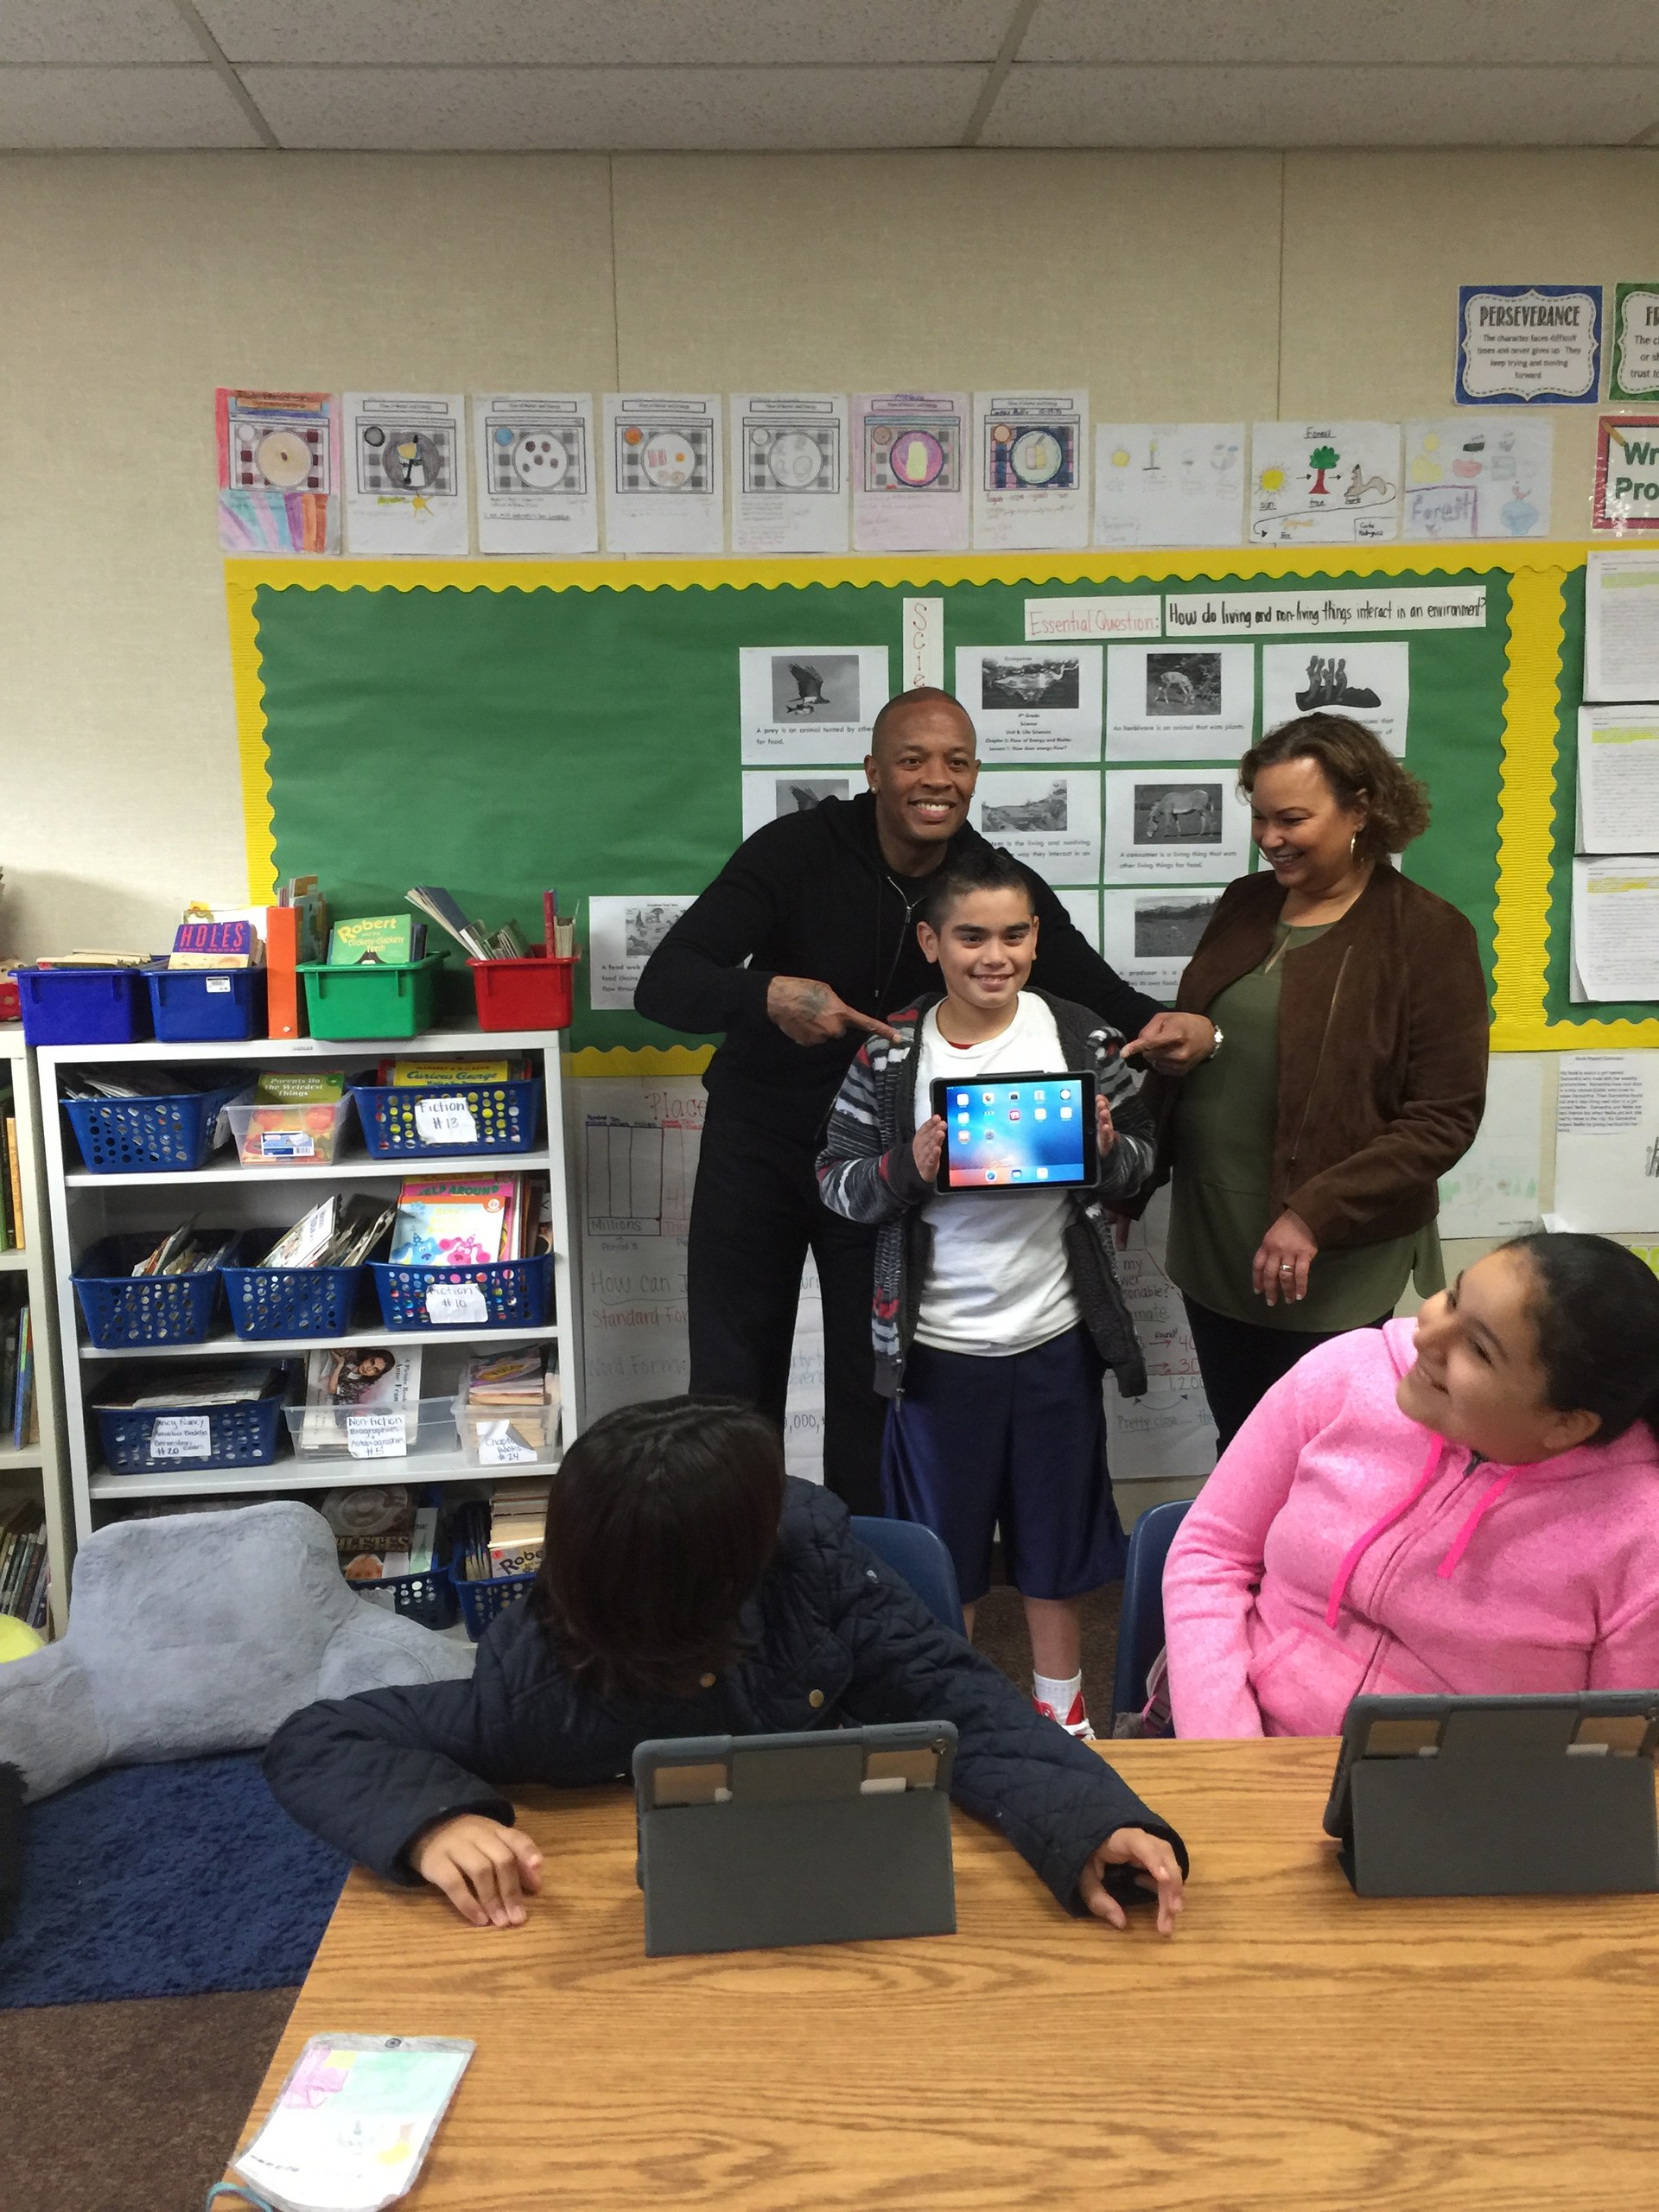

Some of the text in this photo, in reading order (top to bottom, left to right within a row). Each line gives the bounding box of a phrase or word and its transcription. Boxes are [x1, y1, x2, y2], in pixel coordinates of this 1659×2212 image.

[1479, 305, 1580, 327] PERSEVERANCE
[1483, 334, 1577, 342] The character faces difficult
[1634, 334, 1651, 345] The
[1565, 346, 1582, 355] They
[1490, 359, 1506, 367] keep
[1508, 359, 1528, 368] trying
[1543, 359, 1568, 368] moving
[1640, 353, 1649, 362] or
[1630, 368, 1650, 378] trust
[1306, 426, 1332, 438] Forest
[1624, 441, 1659, 466] Wr
[1615, 476, 1659, 500] Pro
[1169, 602, 1198, 626] How
[1202, 601, 1217, 624] do
[1221, 601, 1252, 629] living
[1255, 606, 1272, 623] and
[1322, 601, 1352, 625] things
[1357, 601, 1392, 620] interact
[1396, 604, 1407, 619] in
[1409, 604, 1424, 618] an
[1029, 609, 1160, 636] Essential Question:
[179, 922, 245, 948] HOLES
[337, 918, 397, 944] Robert
[406, 1071, 498, 1080] Curious George
[419, 1101, 466, 1113] Fiction
[645, 1091, 708, 1121] Place
[448, 1185, 500, 1196] AROUND
[591, 1219, 643, 1232] Millions
[590, 1268, 631, 1294] How
[592, 1306, 660, 1330] Standard
[350, 1426, 399, 1438] Biographies
